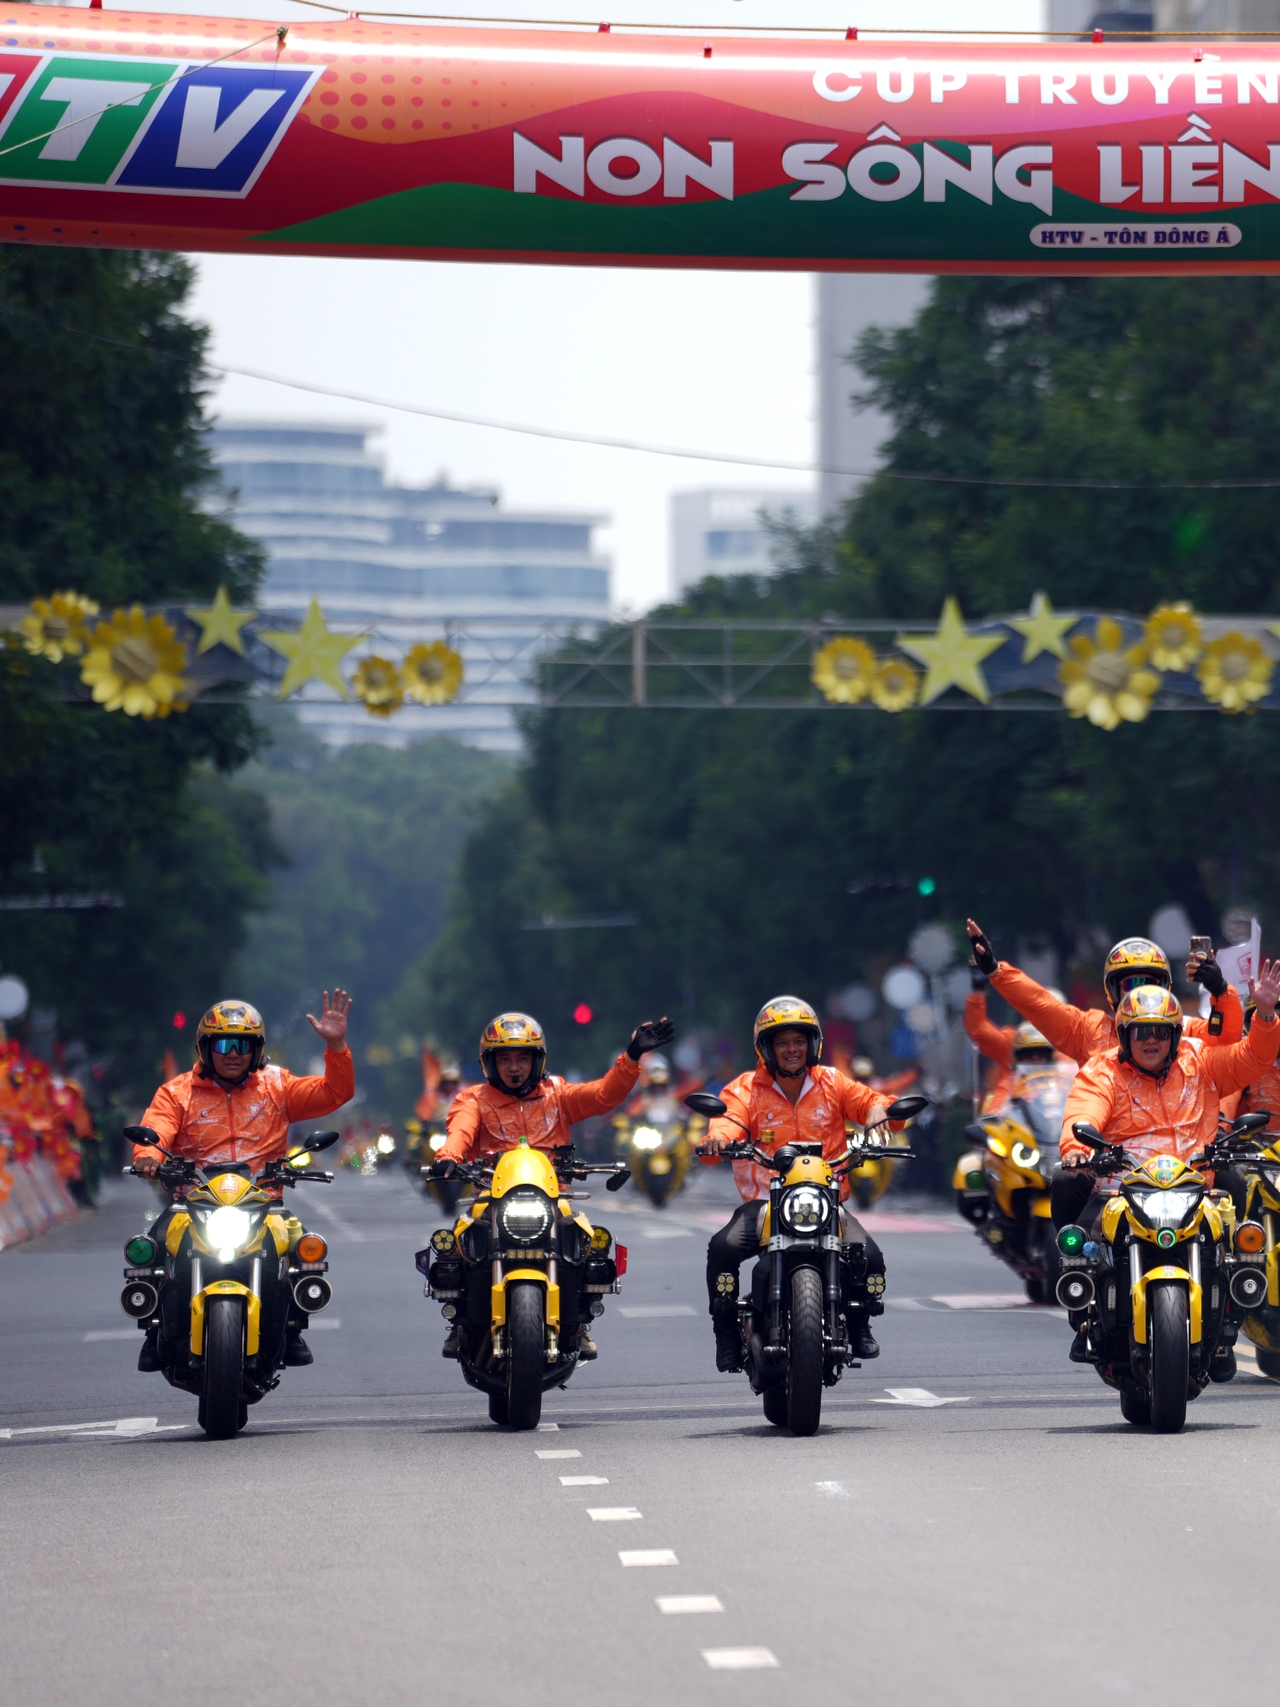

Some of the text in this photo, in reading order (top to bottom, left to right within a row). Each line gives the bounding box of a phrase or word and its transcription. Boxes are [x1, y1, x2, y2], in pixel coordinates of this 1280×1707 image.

[0, 73, 288, 171] TV
[513, 130, 735, 202] NON
[781, 124, 1053, 217] SÔNG
[1040, 230, 1084, 245] HTV
[1104, 227, 1148, 245] TÔN
[1153, 227, 1211, 245] ĐÔNG
[1215, 226, 1232, 245] Á
